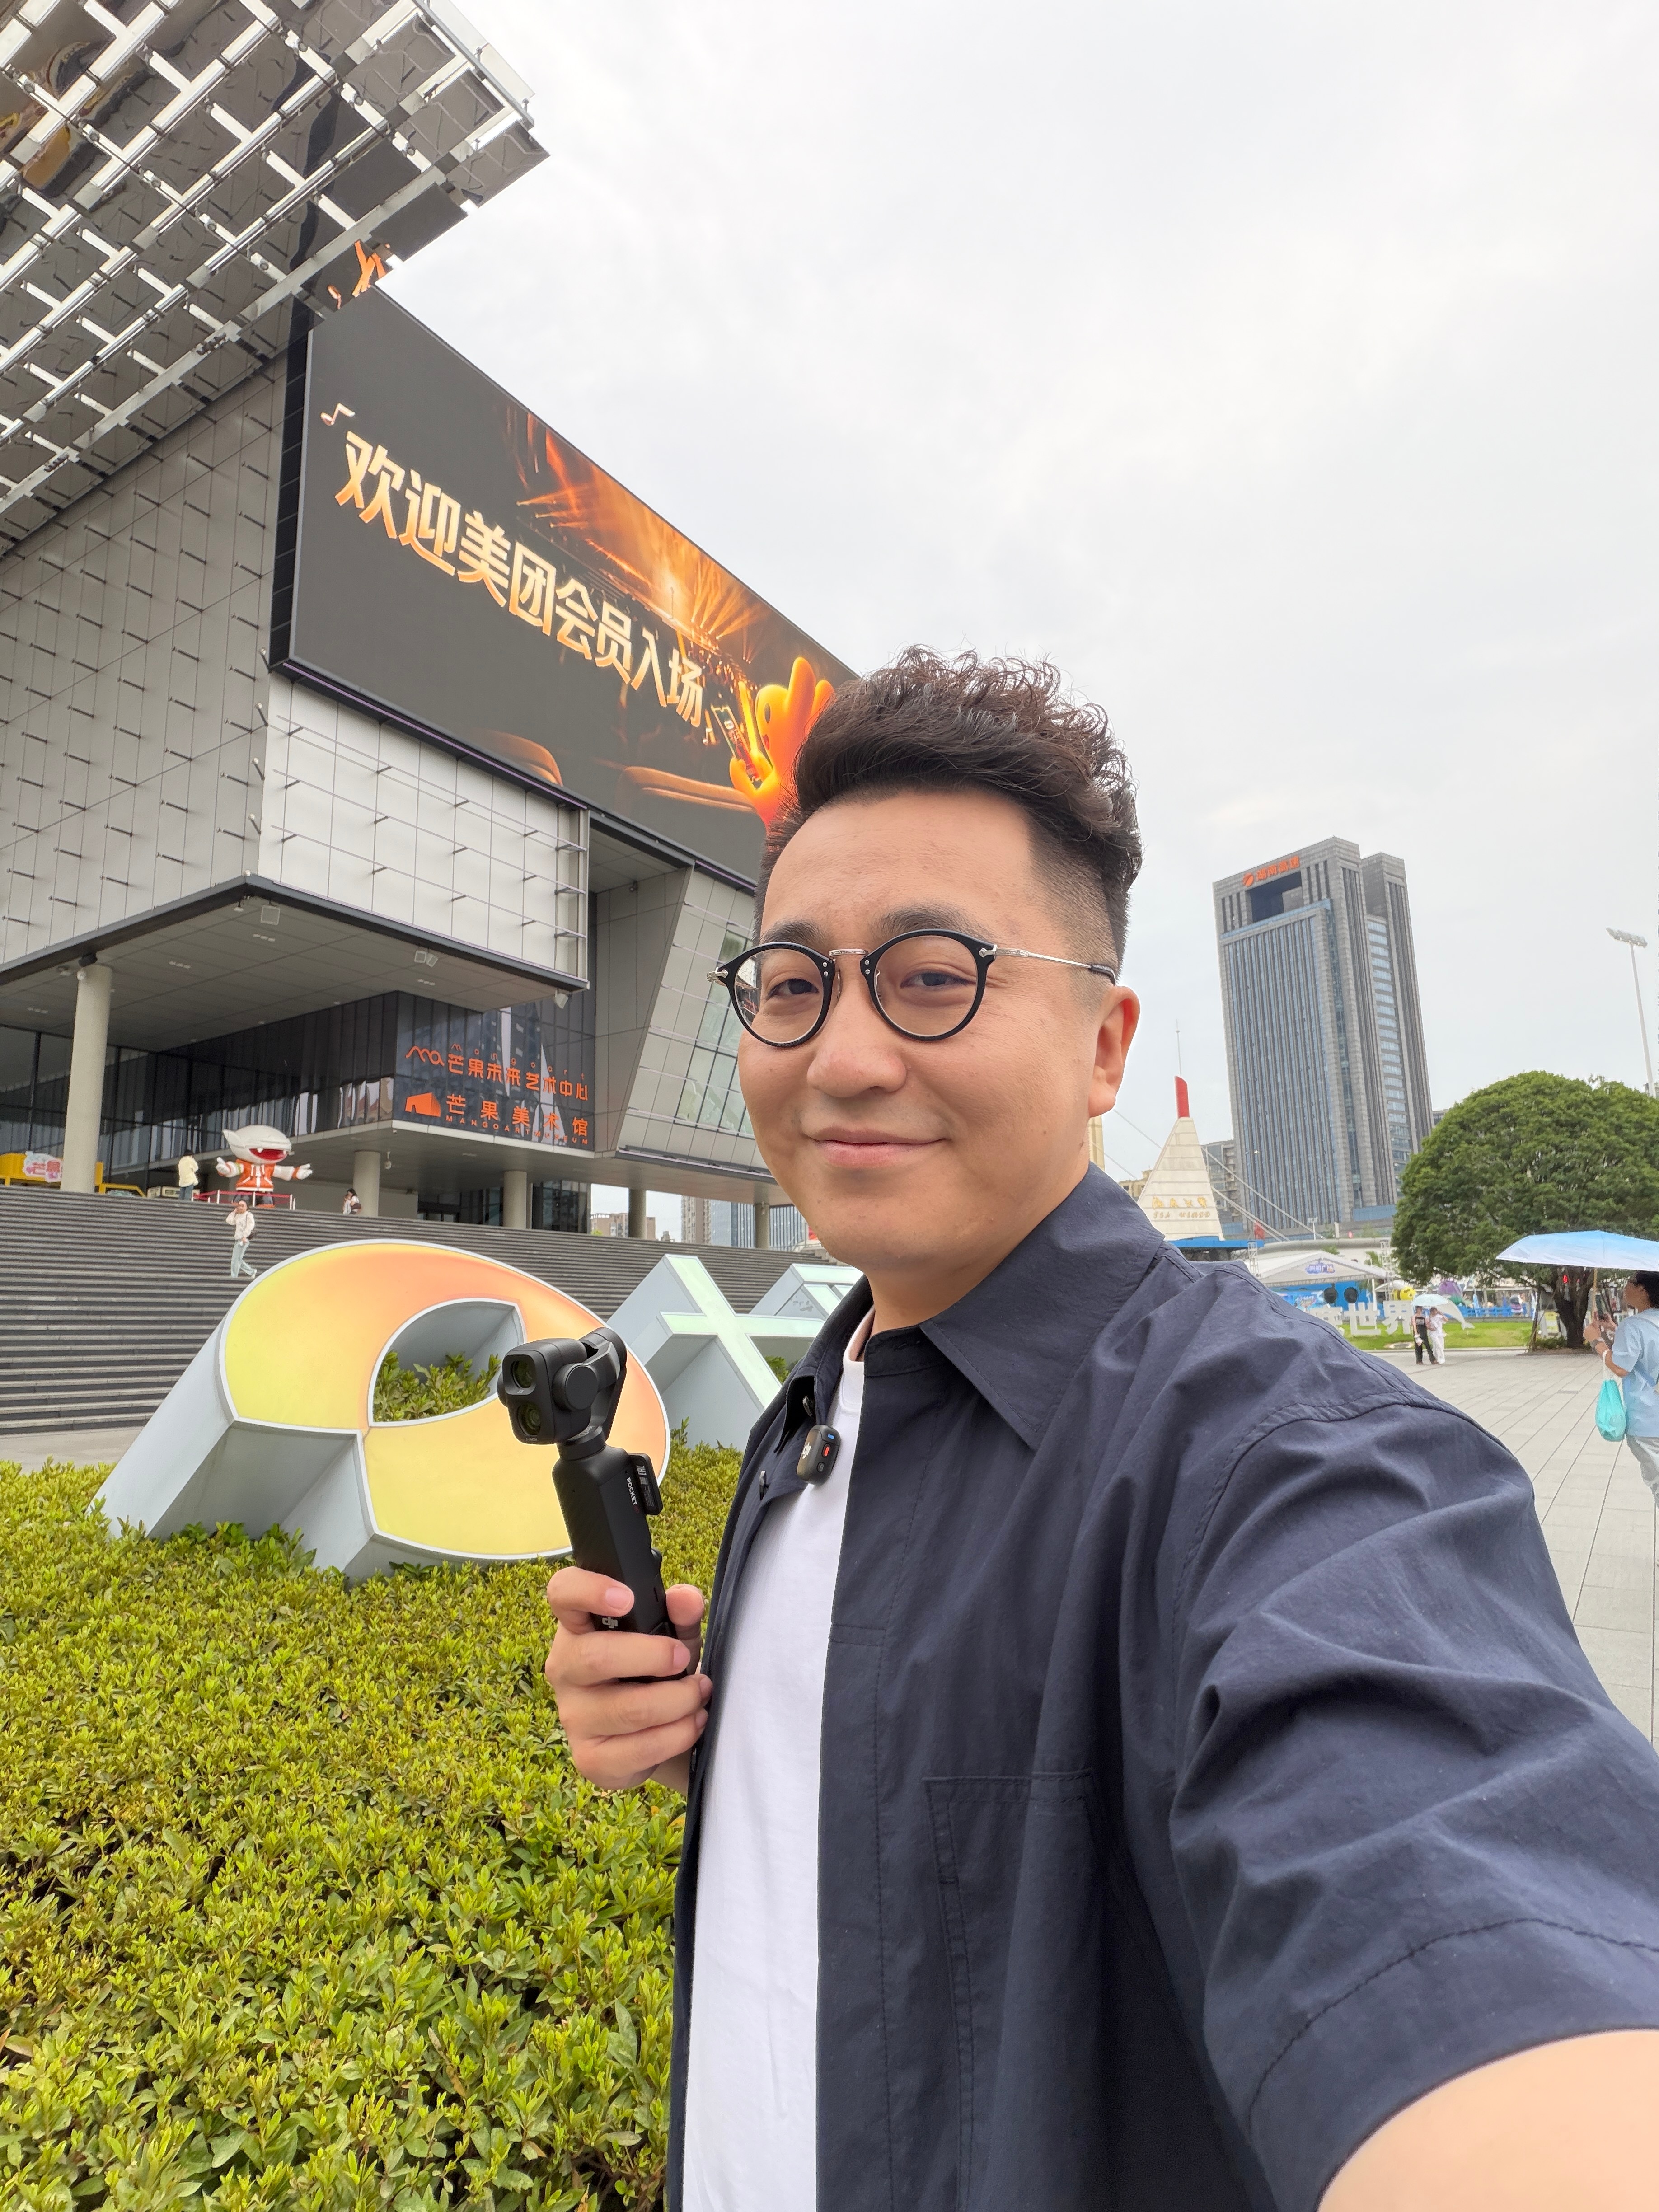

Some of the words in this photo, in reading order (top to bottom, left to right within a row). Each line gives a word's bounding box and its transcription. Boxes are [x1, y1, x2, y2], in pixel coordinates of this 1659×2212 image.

[335, 431, 703, 728] 欢迎美团会员入场
[447, 1053, 588, 1101] 芒果未来艺术中心
[446, 1093, 588, 1137] 芒果美术馆
[626, 1476, 637, 1505] POCKET
